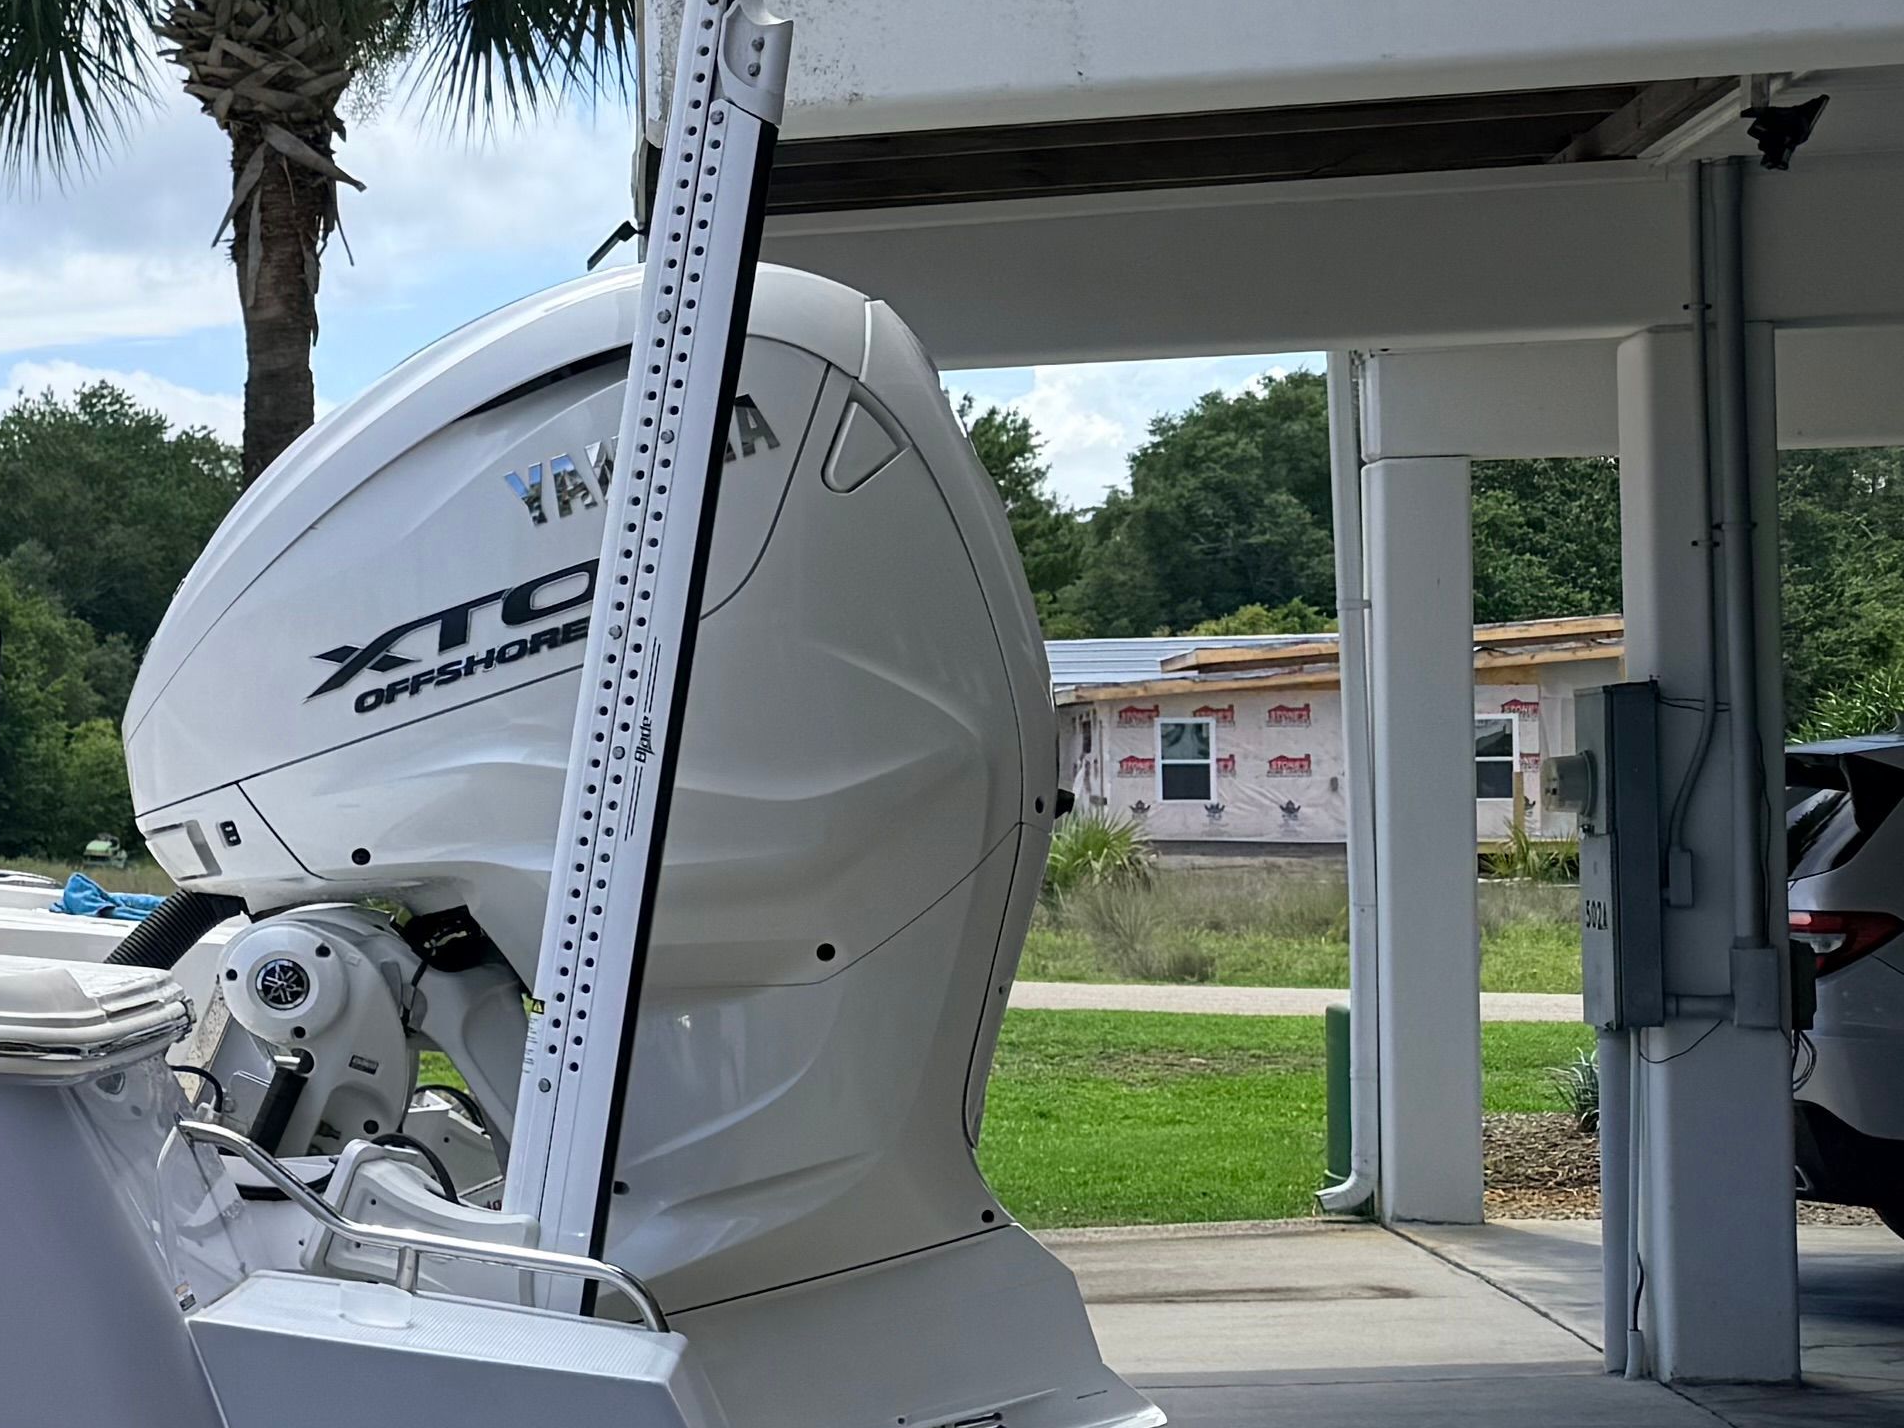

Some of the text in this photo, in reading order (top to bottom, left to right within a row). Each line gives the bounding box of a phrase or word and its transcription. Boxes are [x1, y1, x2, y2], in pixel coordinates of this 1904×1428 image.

[303, 557, 600, 703] XTO
[354, 616, 591, 715] OFFSHORE
[634, 715, 655, 763] Blade
